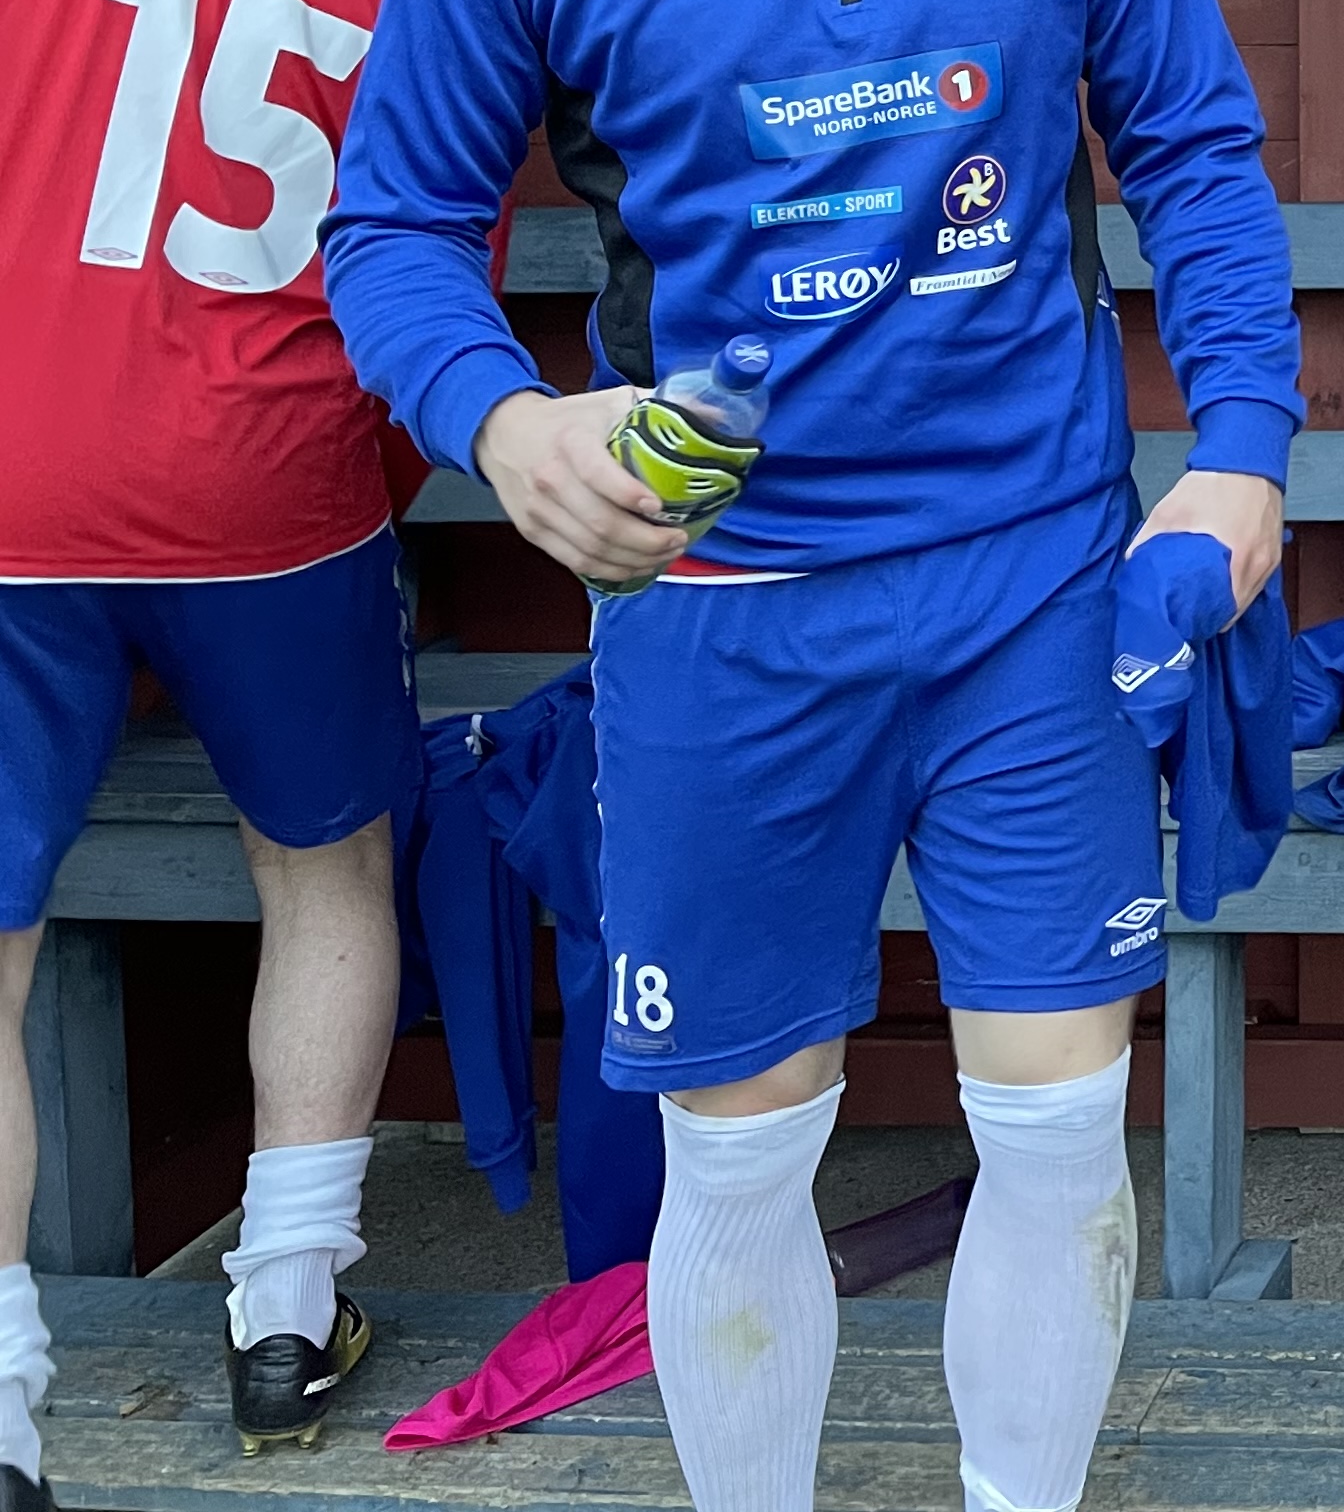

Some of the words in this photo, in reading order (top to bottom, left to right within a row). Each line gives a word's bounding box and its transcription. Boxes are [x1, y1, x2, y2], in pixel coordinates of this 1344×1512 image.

[761, 71, 934, 126] SpareBank
[950, 68, 974, 102] 1
[812, 100, 937, 137] NORD-NORGE
[983, 162, 994, 176] B
[756, 201, 830, 224] ELEKTRO
[844, 192, 895, 213] SPORT
[936, 218, 1012, 255] Best
[771, 262, 894, 304] LERØY
[1109, 926, 1159, 957] umbro
[612, 952, 675, 1033] 18
